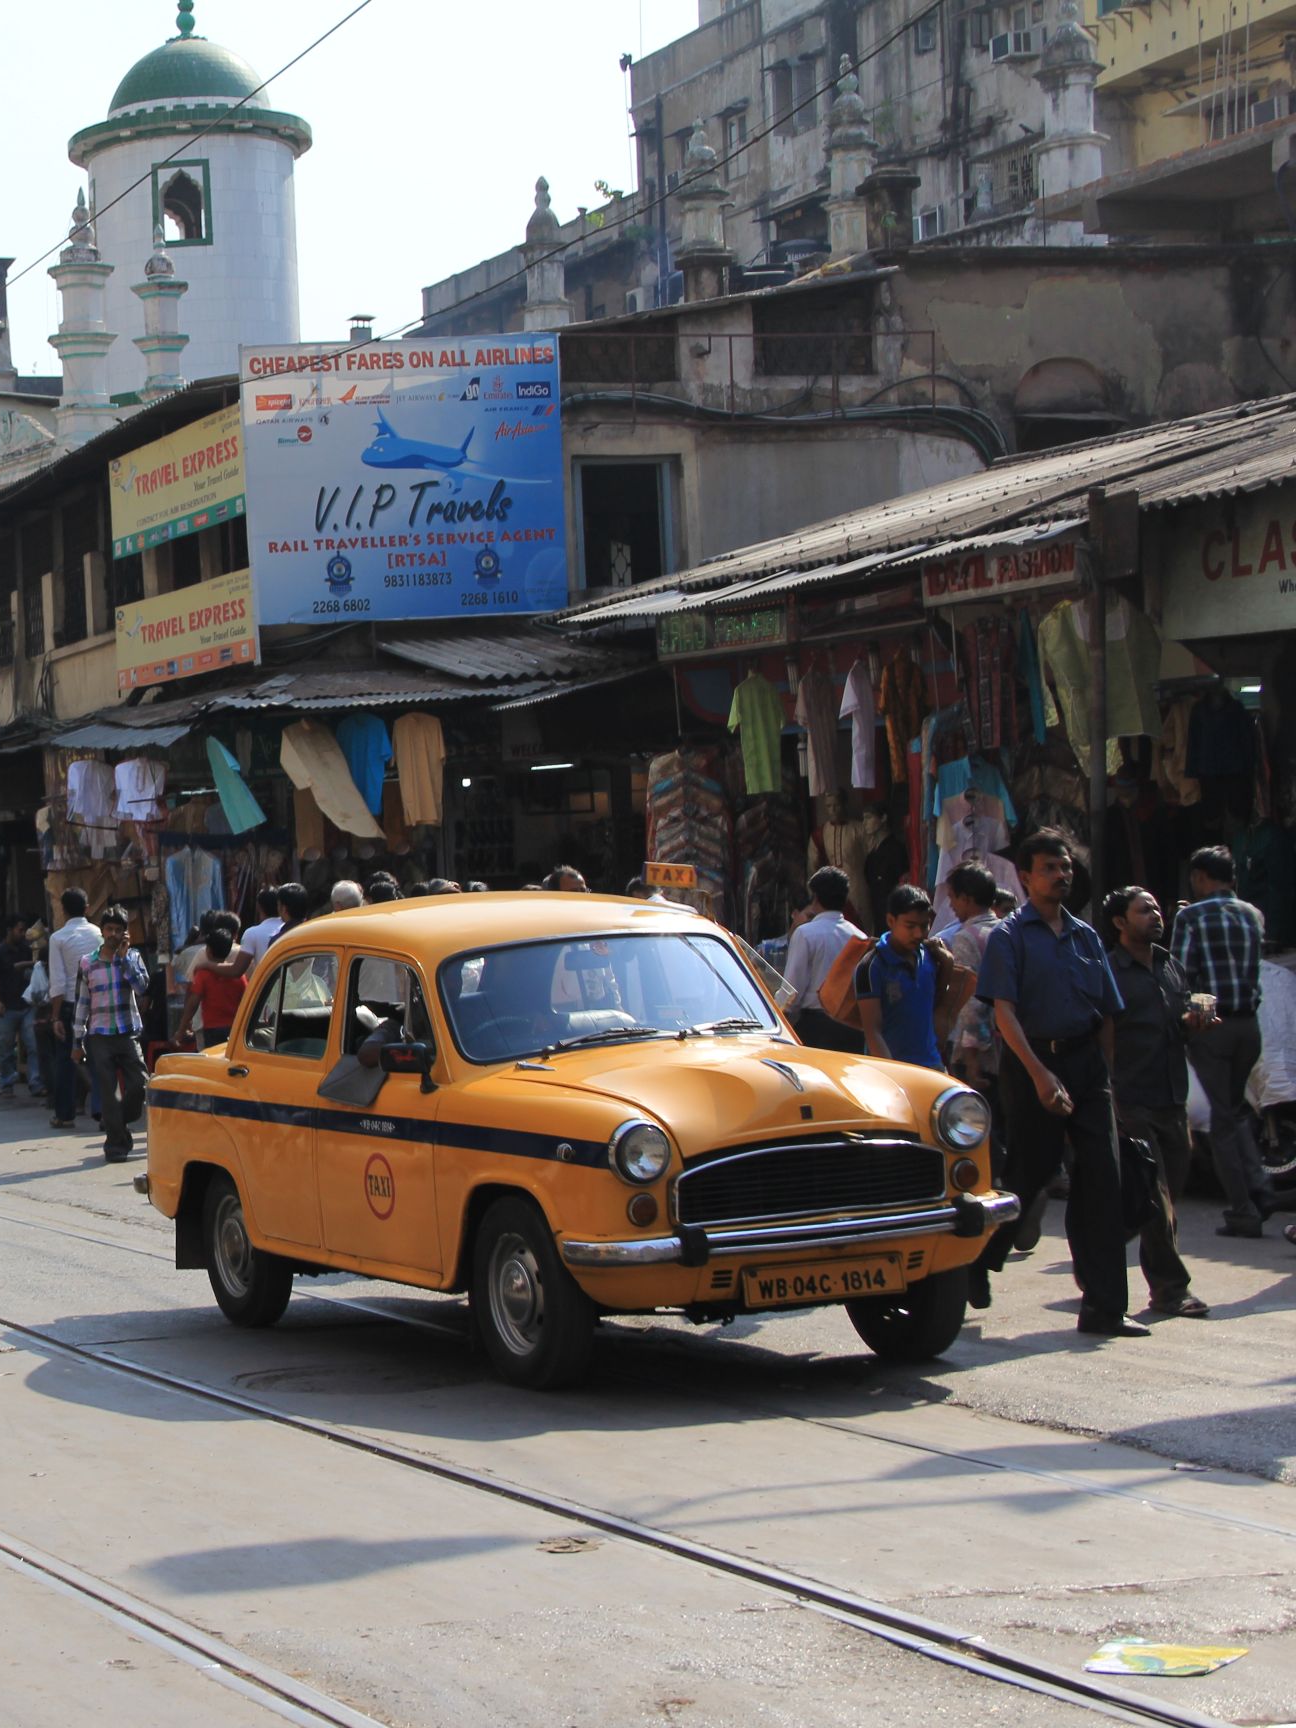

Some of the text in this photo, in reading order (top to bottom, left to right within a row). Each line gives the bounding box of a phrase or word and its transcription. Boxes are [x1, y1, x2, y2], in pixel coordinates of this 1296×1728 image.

[249, 346, 554, 375] CHEAPEST FARES ON ALL AIRLINES
[518, 385, 549, 397] IndiGo
[282, 416, 313, 424] AIRWAYS
[134, 435, 240, 497] TRAVEL EXPRESS
[193, 465, 240, 492] Your Travel Guide
[408, 479, 513, 529] Travels
[268, 527, 557, 554] RAIL TRAVELLER'S SERVICE AGENT
[1201, 518, 1296, 581] CLA
[388, 552, 447, 570] [RTSA]
[997, 542, 1075, 584] FASHION
[384, 572, 452, 588] 9831183873
[1279, 578, 1296, 594] Wh
[313, 598, 371, 614] 2268 6802
[461, 592, 489, 607] 2268
[140, 598, 246, 644] TRAVEL EXPRESS
[199, 625, 247, 645] Your Travel Guide
[650, 867, 694, 882] TAXI
[368, 1174, 391, 1198] TAXI
[841, 1268, 887, 1292] 1814
